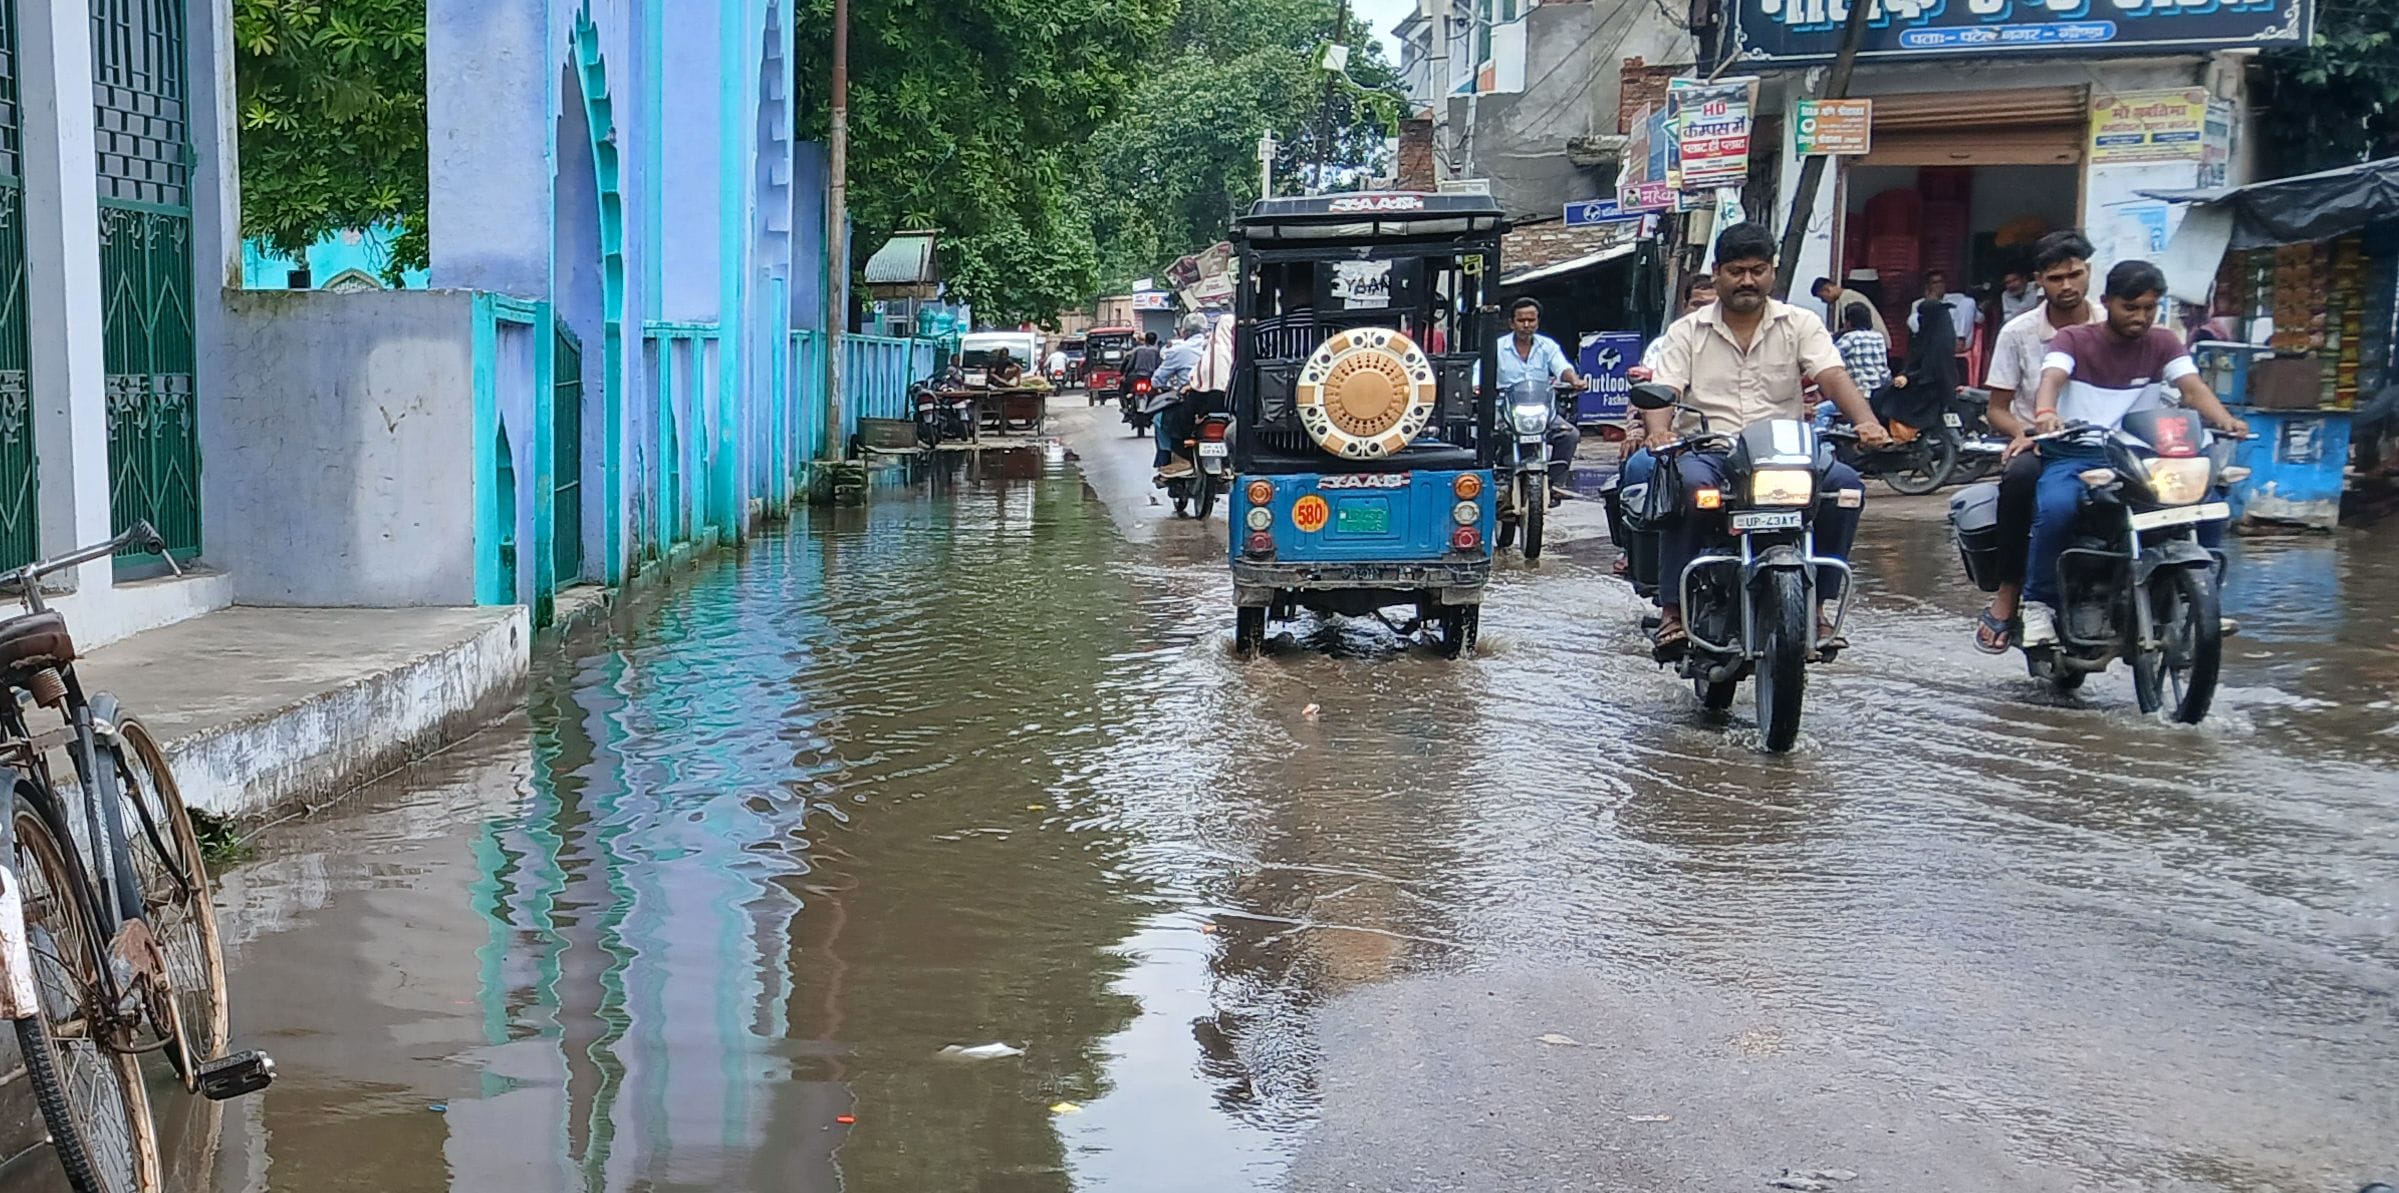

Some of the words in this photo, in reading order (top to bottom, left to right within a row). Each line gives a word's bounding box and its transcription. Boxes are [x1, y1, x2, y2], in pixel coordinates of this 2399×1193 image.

[2001, 28, 2041, 42] नगर
[1703, 102, 1727, 116] HD
[1298, 502, 1324, 525] 580
